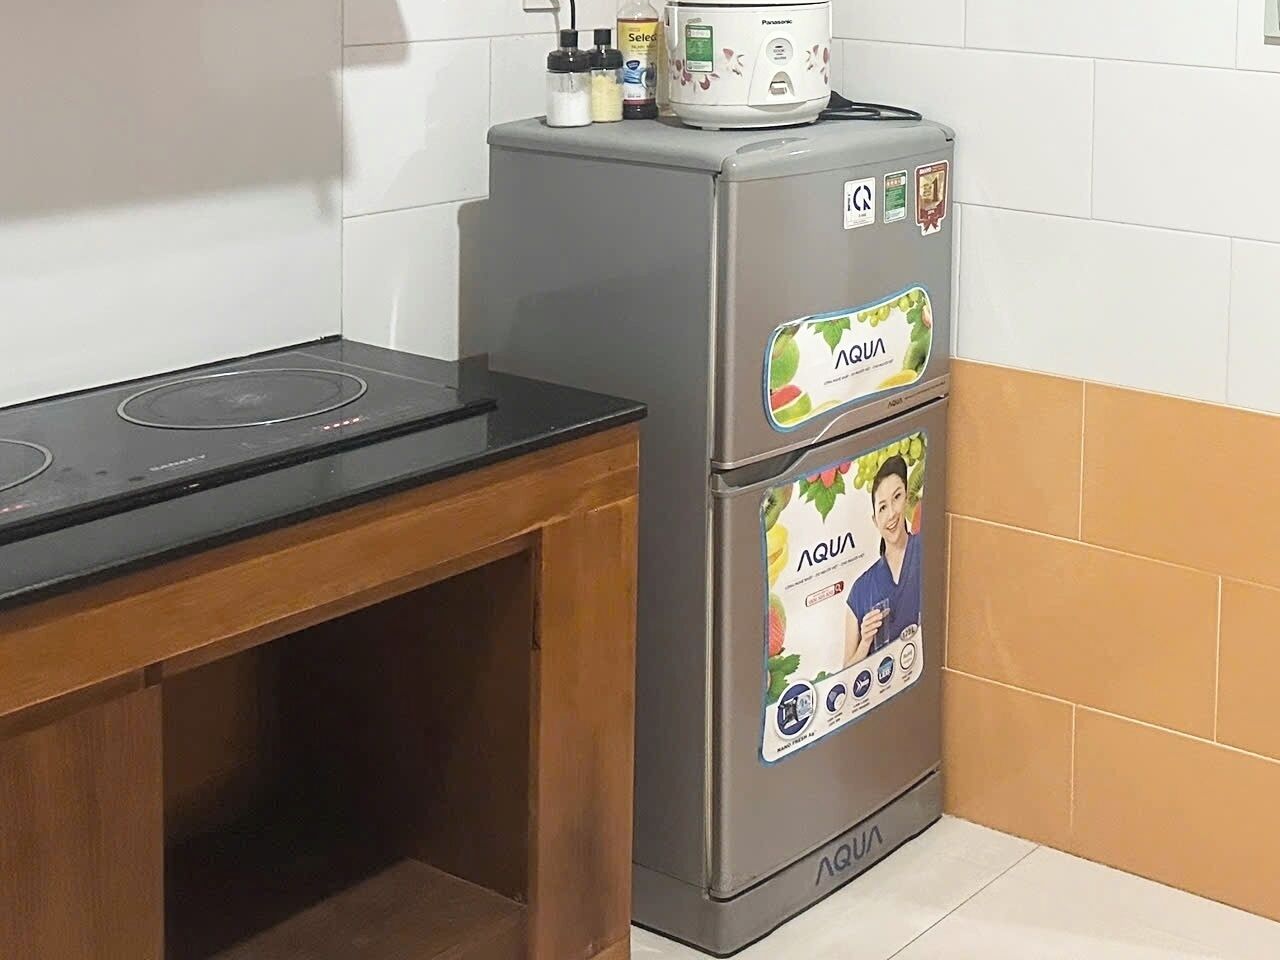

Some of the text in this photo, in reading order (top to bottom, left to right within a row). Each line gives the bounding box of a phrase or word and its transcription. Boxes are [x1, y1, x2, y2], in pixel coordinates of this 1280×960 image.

[834, 337, 886, 370] AQUA
[797, 532, 855, 572] AQUA
[776, 742, 792, 753] NANO
[815, 825, 883, 887] AQUA
